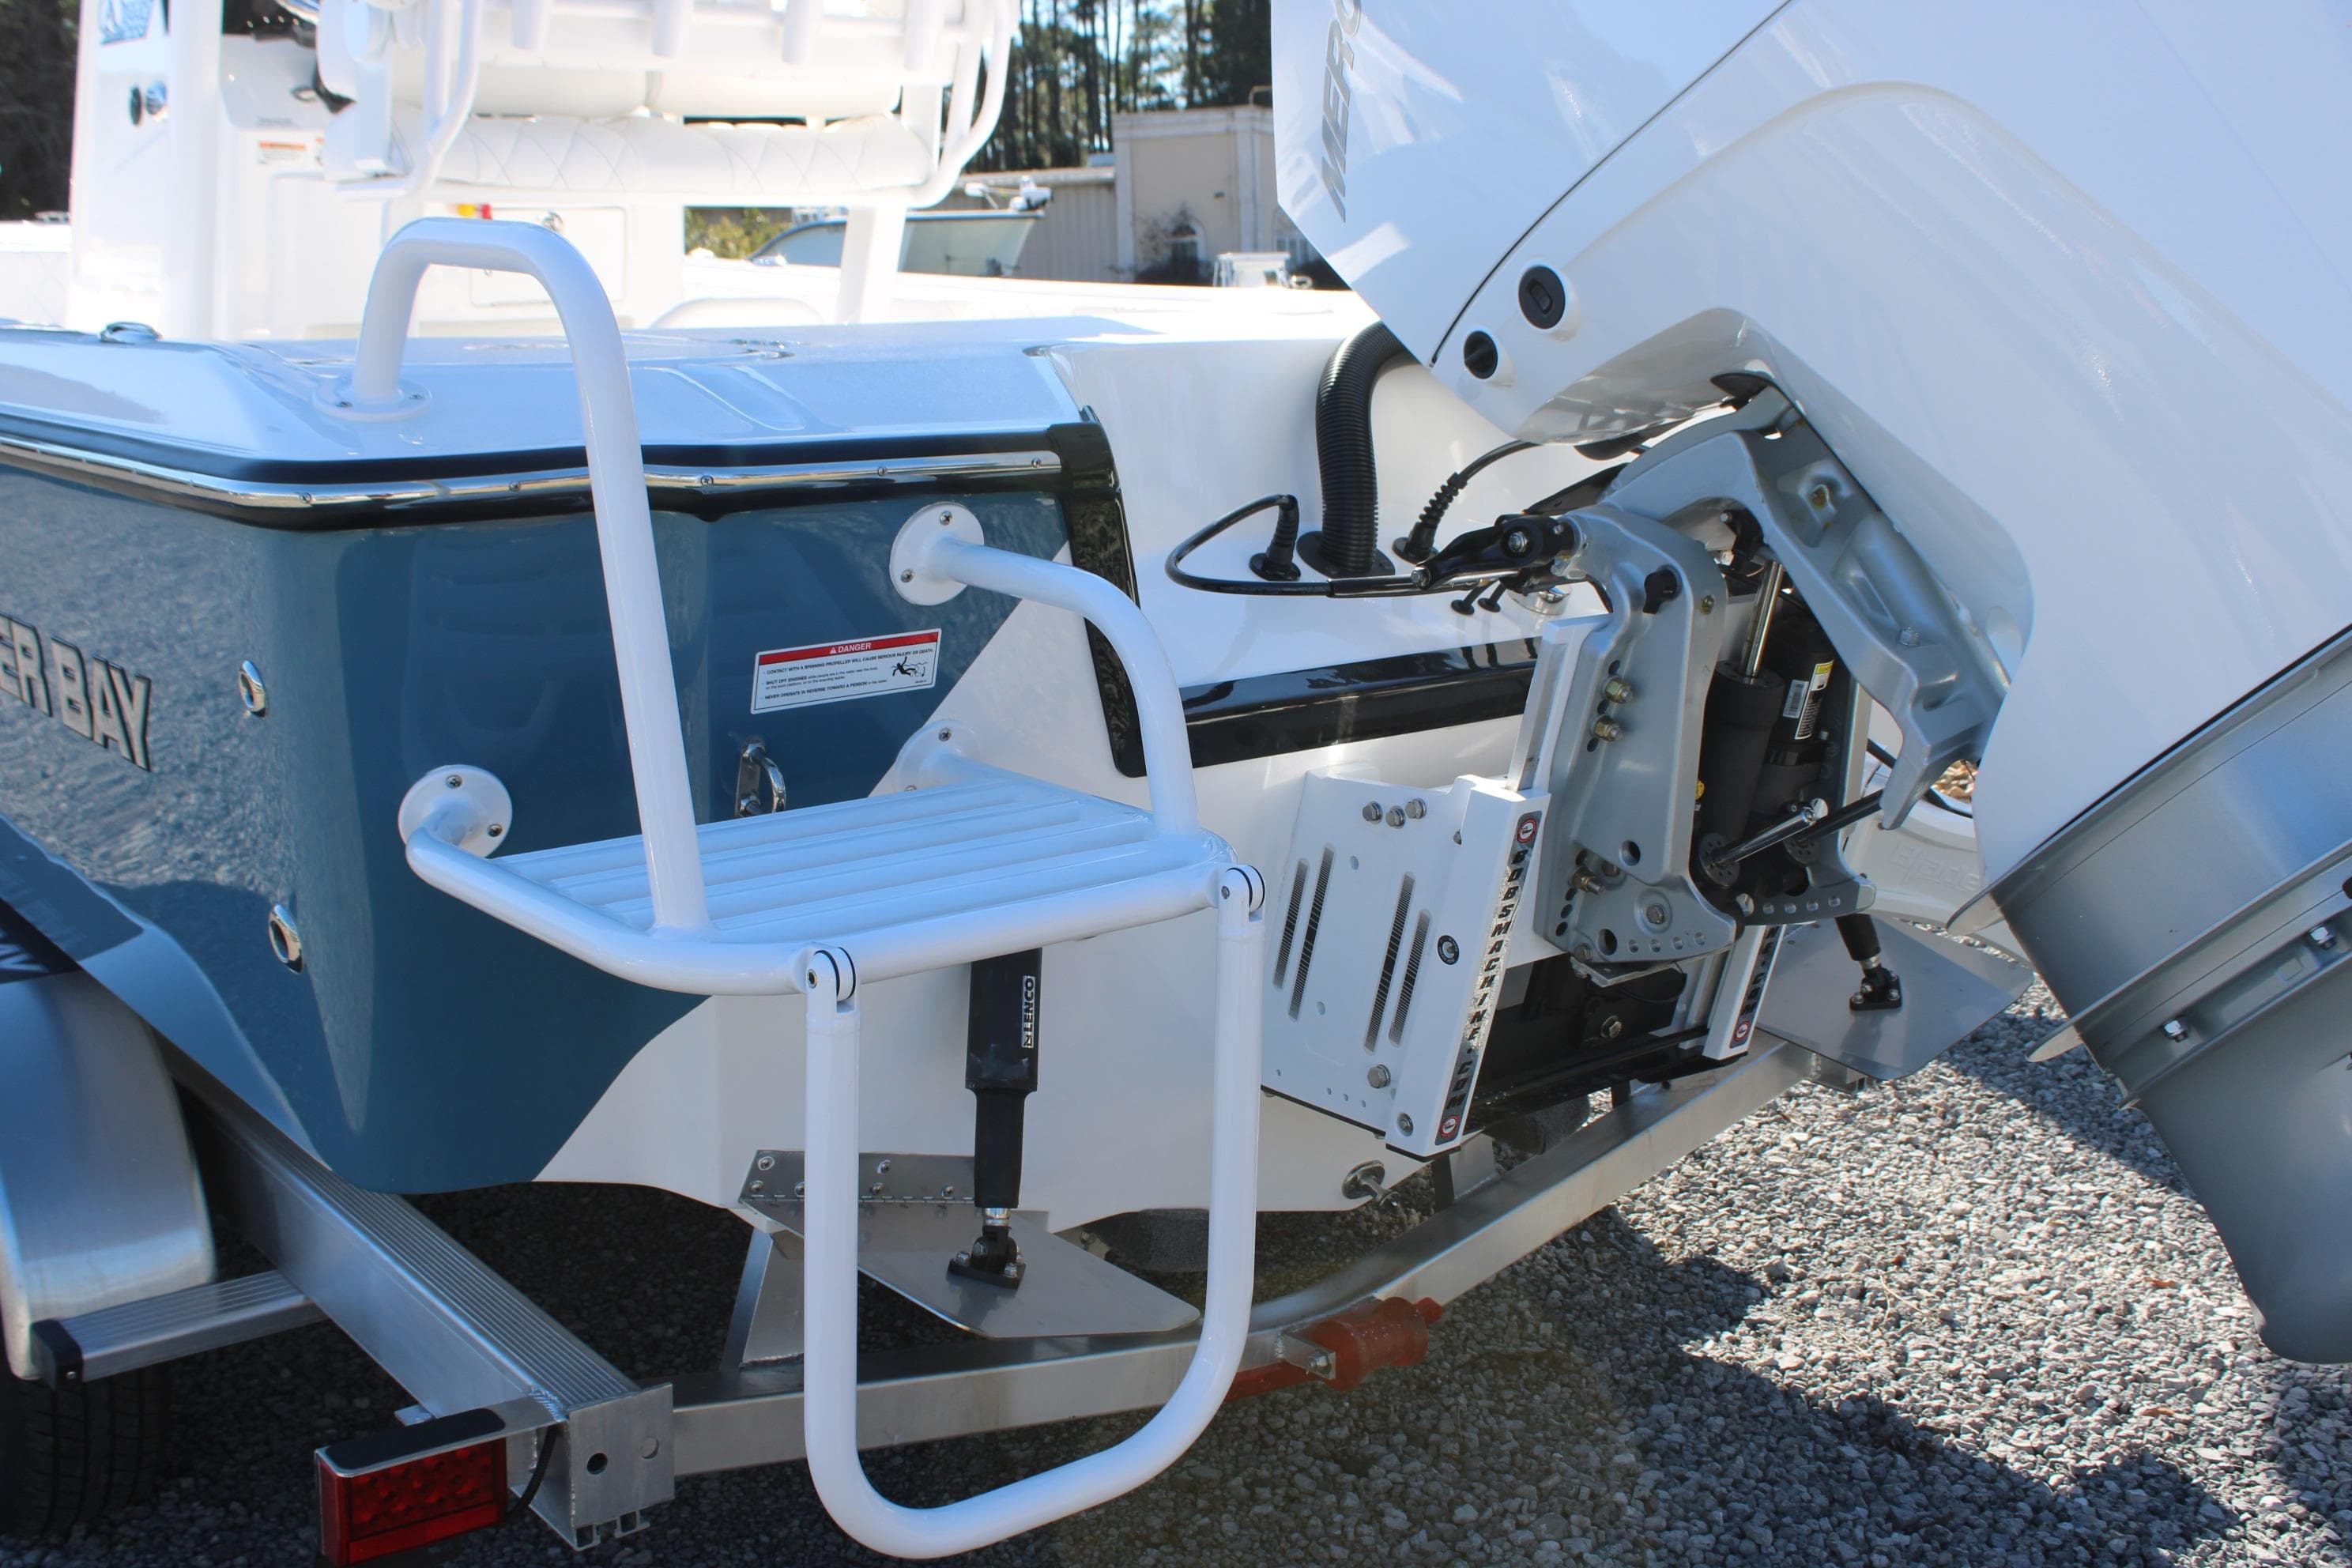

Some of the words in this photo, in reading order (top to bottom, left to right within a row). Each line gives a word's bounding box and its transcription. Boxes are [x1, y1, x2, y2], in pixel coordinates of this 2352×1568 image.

[838, 642, 872, 654] DANGER
[50, 635, 152, 772] BAY
[1023, 978, 1035, 1032] LENCO
